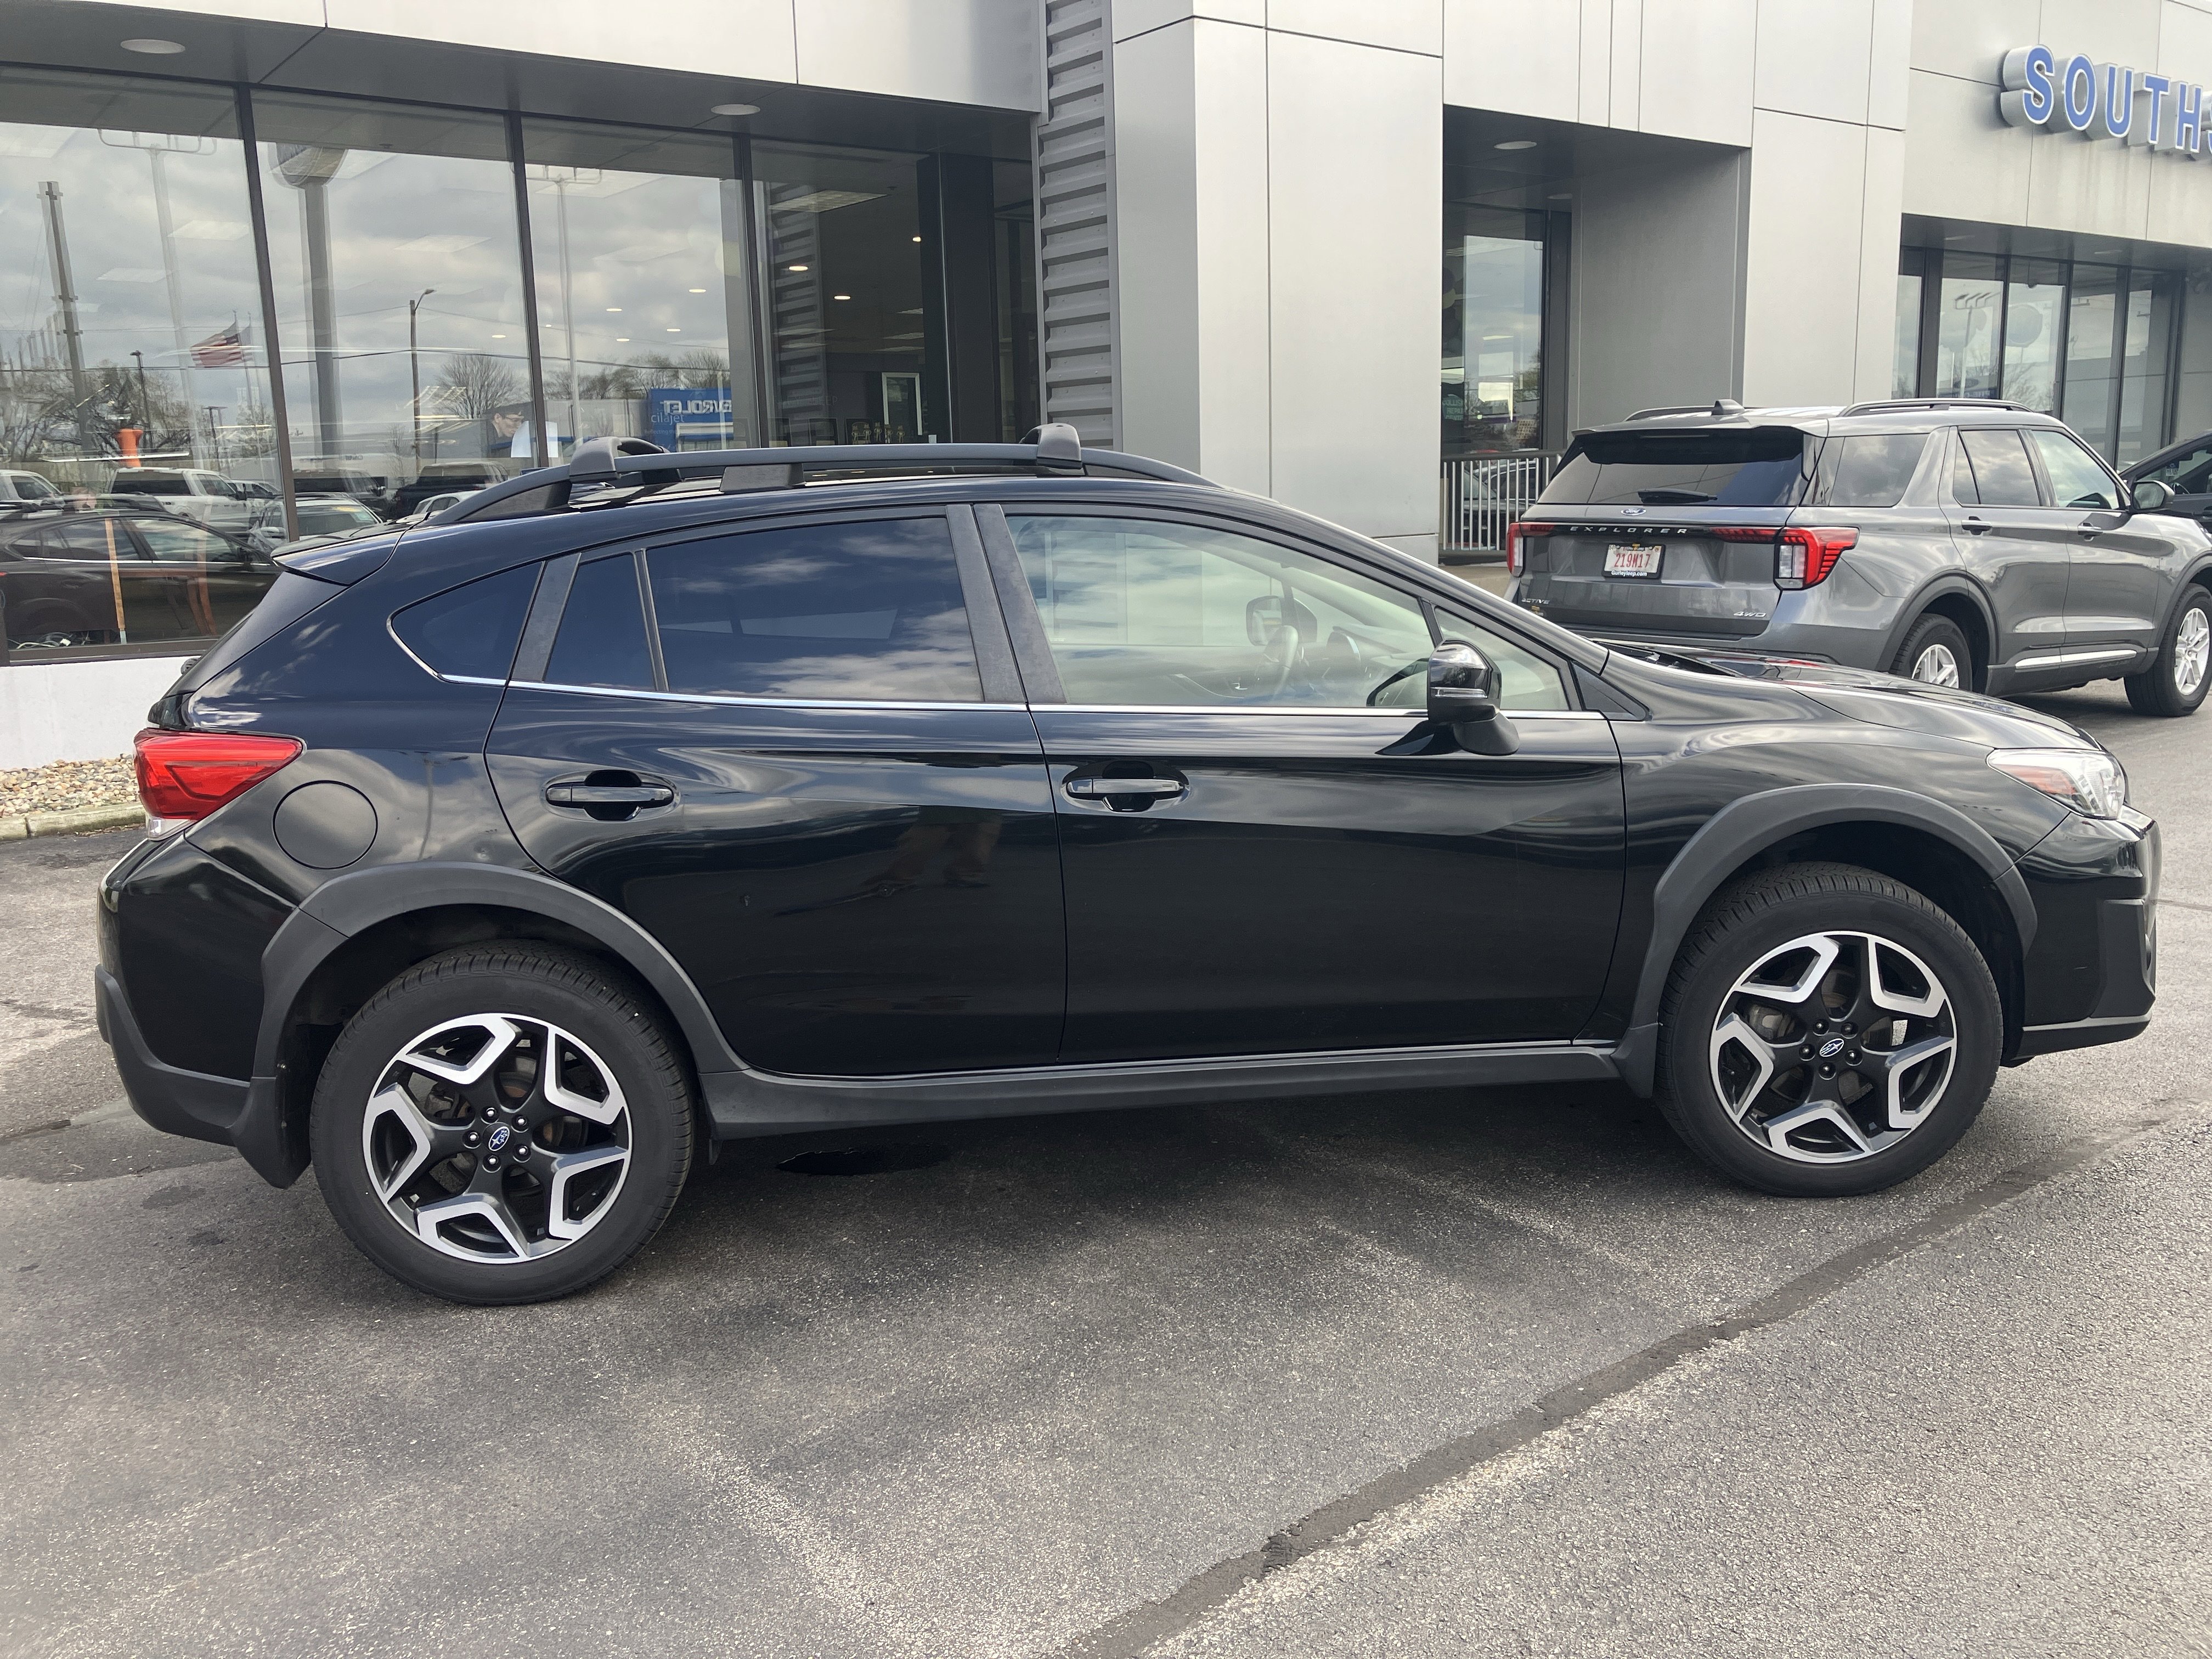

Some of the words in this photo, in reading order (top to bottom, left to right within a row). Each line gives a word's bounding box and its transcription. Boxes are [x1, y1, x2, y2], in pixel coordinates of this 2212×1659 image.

[2022, 44, 2212, 156] SOUTH
[651, 412, 684, 425] cilajet
[1614, 553, 1651, 568] 219M17
